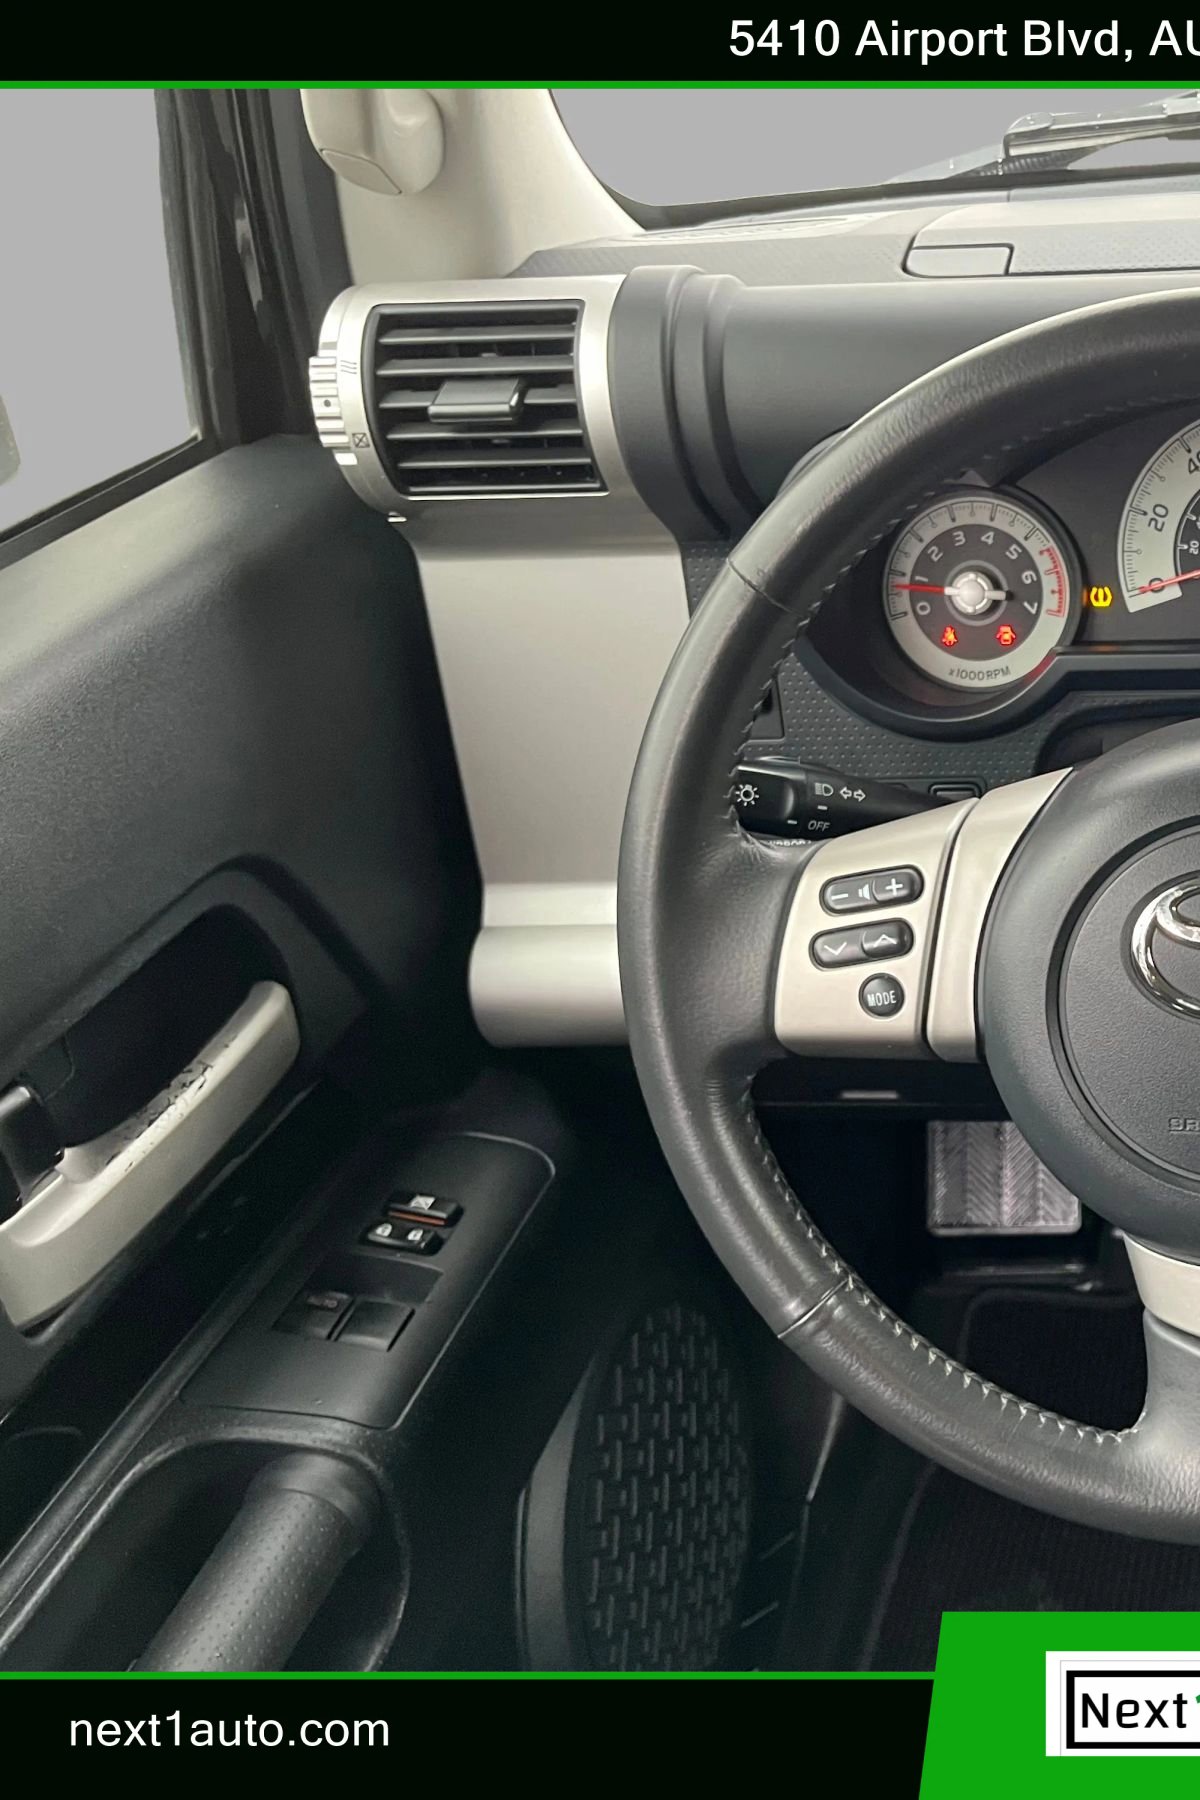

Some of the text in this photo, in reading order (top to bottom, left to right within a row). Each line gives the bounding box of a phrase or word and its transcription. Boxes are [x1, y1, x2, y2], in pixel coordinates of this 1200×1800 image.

[1148, 504, 1169, 532] 20
[952, 531, 966, 547] 3
[980, 531, 995, 545] 4
[927, 546, 943, 563] 2
[1005, 546, 1022, 560] 5
[1189, 540, 1199, 555] 20
[1021, 569, 1037, 585] 6
[917, 602, 931, 615] 0
[1024, 601, 1038, 615] 7
[807, 820, 830, 832] OFF
[867, 990, 897, 1007] MODE
